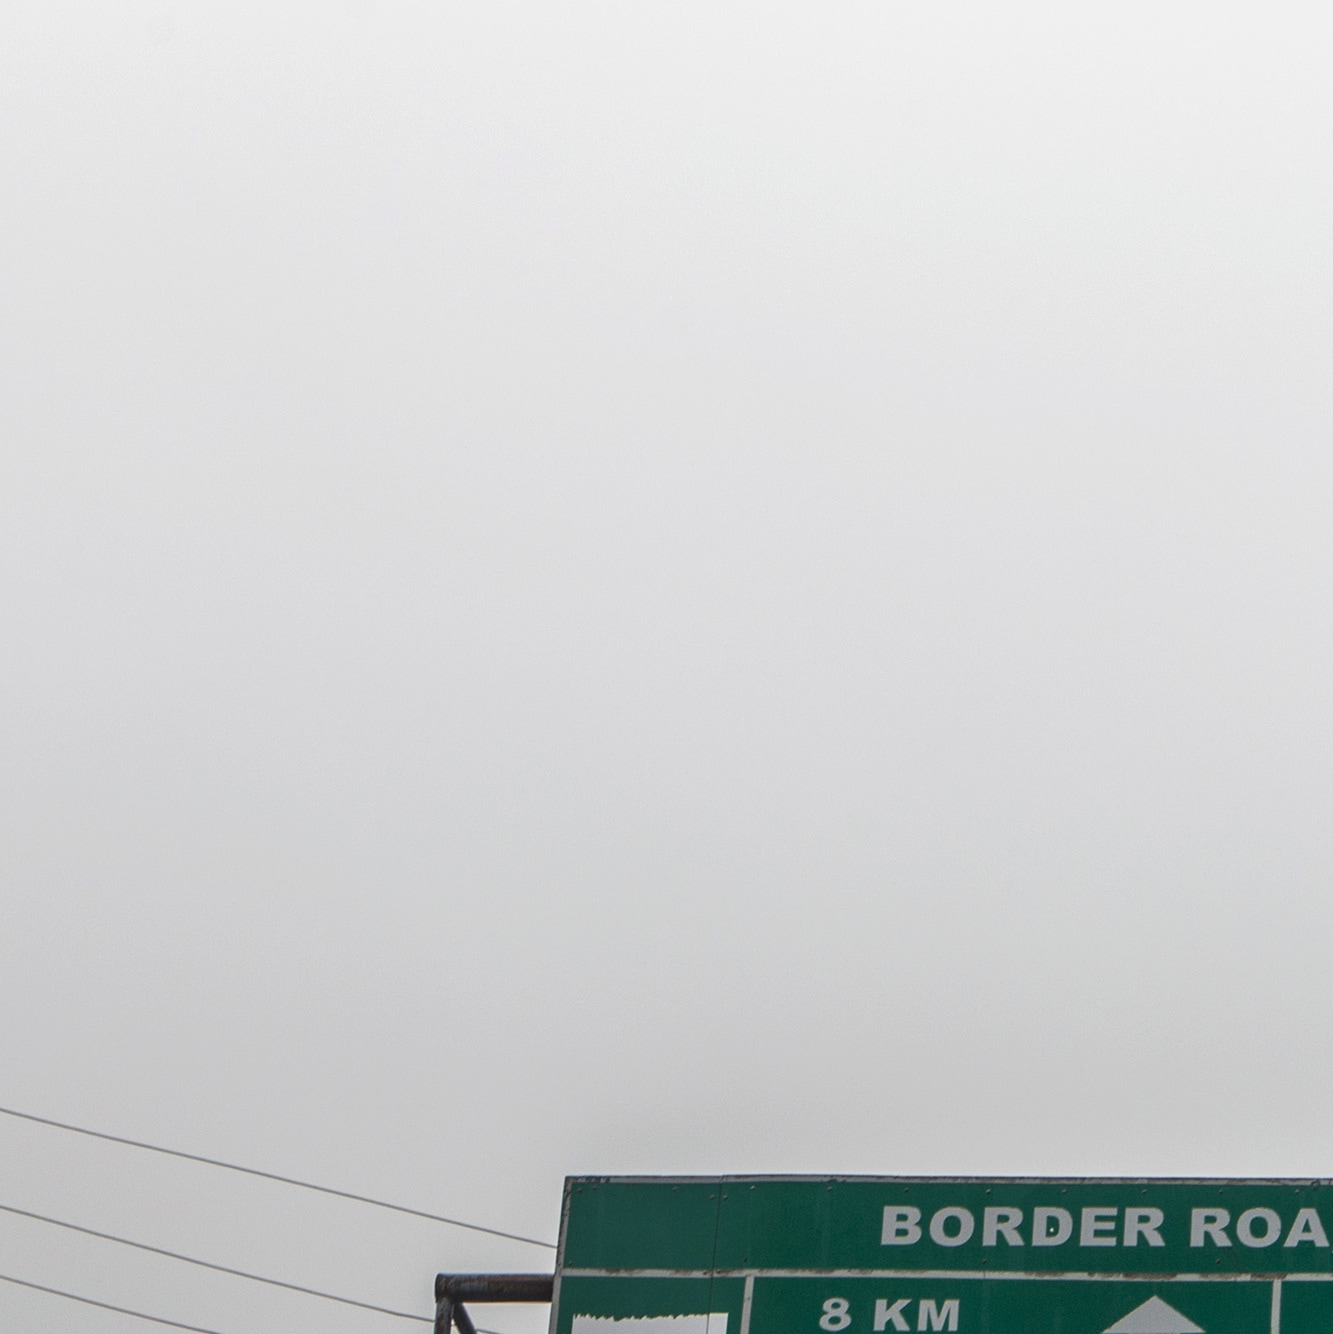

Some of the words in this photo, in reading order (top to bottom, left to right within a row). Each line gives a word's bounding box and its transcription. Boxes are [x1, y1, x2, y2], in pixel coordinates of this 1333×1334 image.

[880, 1205, 1166, 1247] BORDER
[819, 1297, 852, 1332] 8
[873, 1298, 960, 1332] KM
